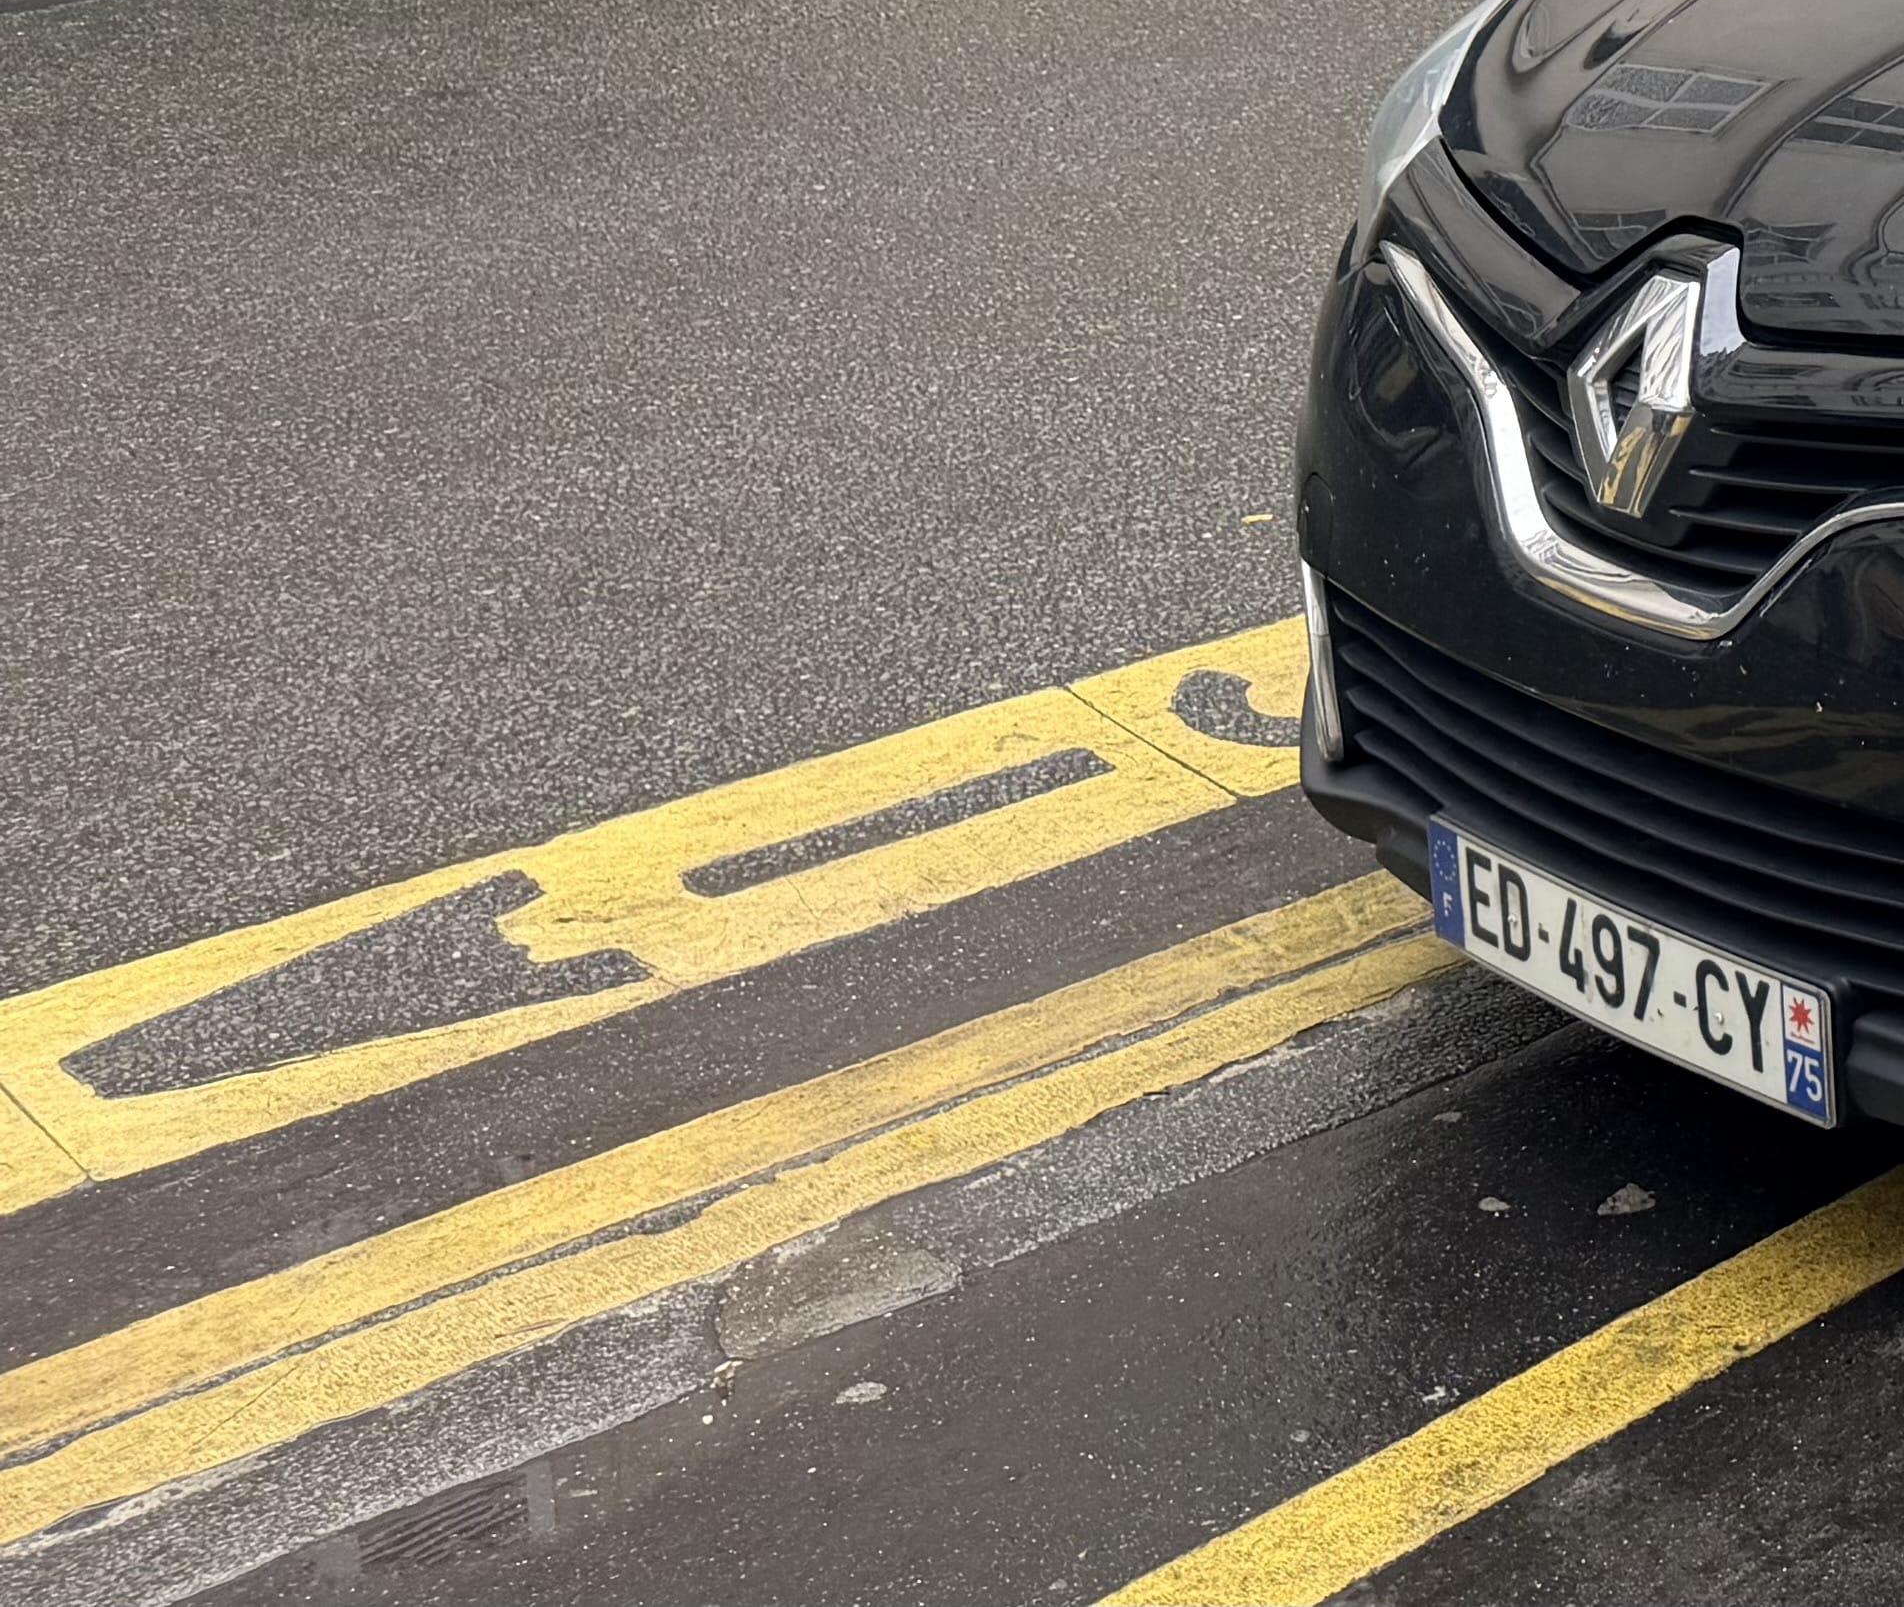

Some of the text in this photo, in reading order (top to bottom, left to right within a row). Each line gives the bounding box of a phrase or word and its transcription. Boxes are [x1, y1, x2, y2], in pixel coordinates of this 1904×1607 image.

[1442, 891, 1453, 917] F
[1465, 846, 1771, 1074] ED-497-CY
[1786, 1051, 1823, 1103] 75
